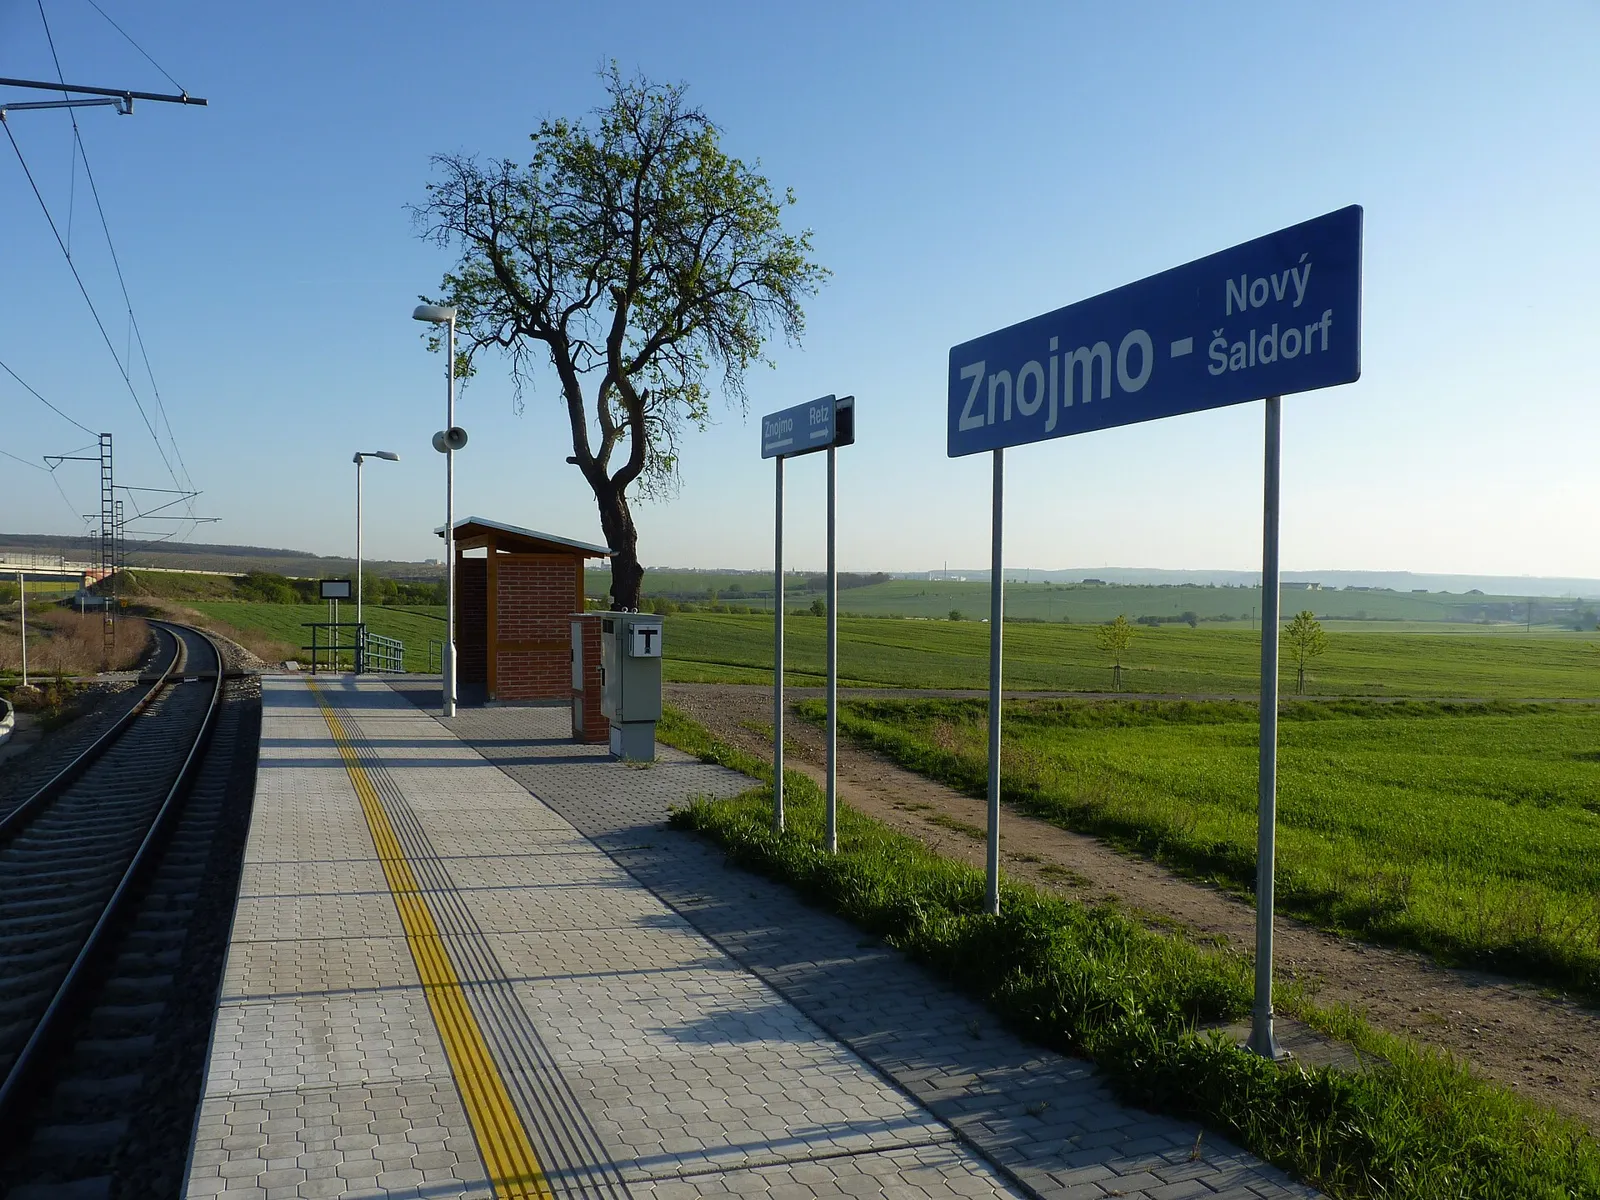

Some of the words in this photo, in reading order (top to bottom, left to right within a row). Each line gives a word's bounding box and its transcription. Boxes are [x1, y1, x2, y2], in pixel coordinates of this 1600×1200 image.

[1225, 252, 1312, 316] Nový
[1207, 308, 1333, 376] Šaldorf
[958, 327, 1154, 433] Znojmo
[764, 417, 794, 439] Znojmo
[809, 405, 829, 426] Retz
[638, 629, 658, 653] T
